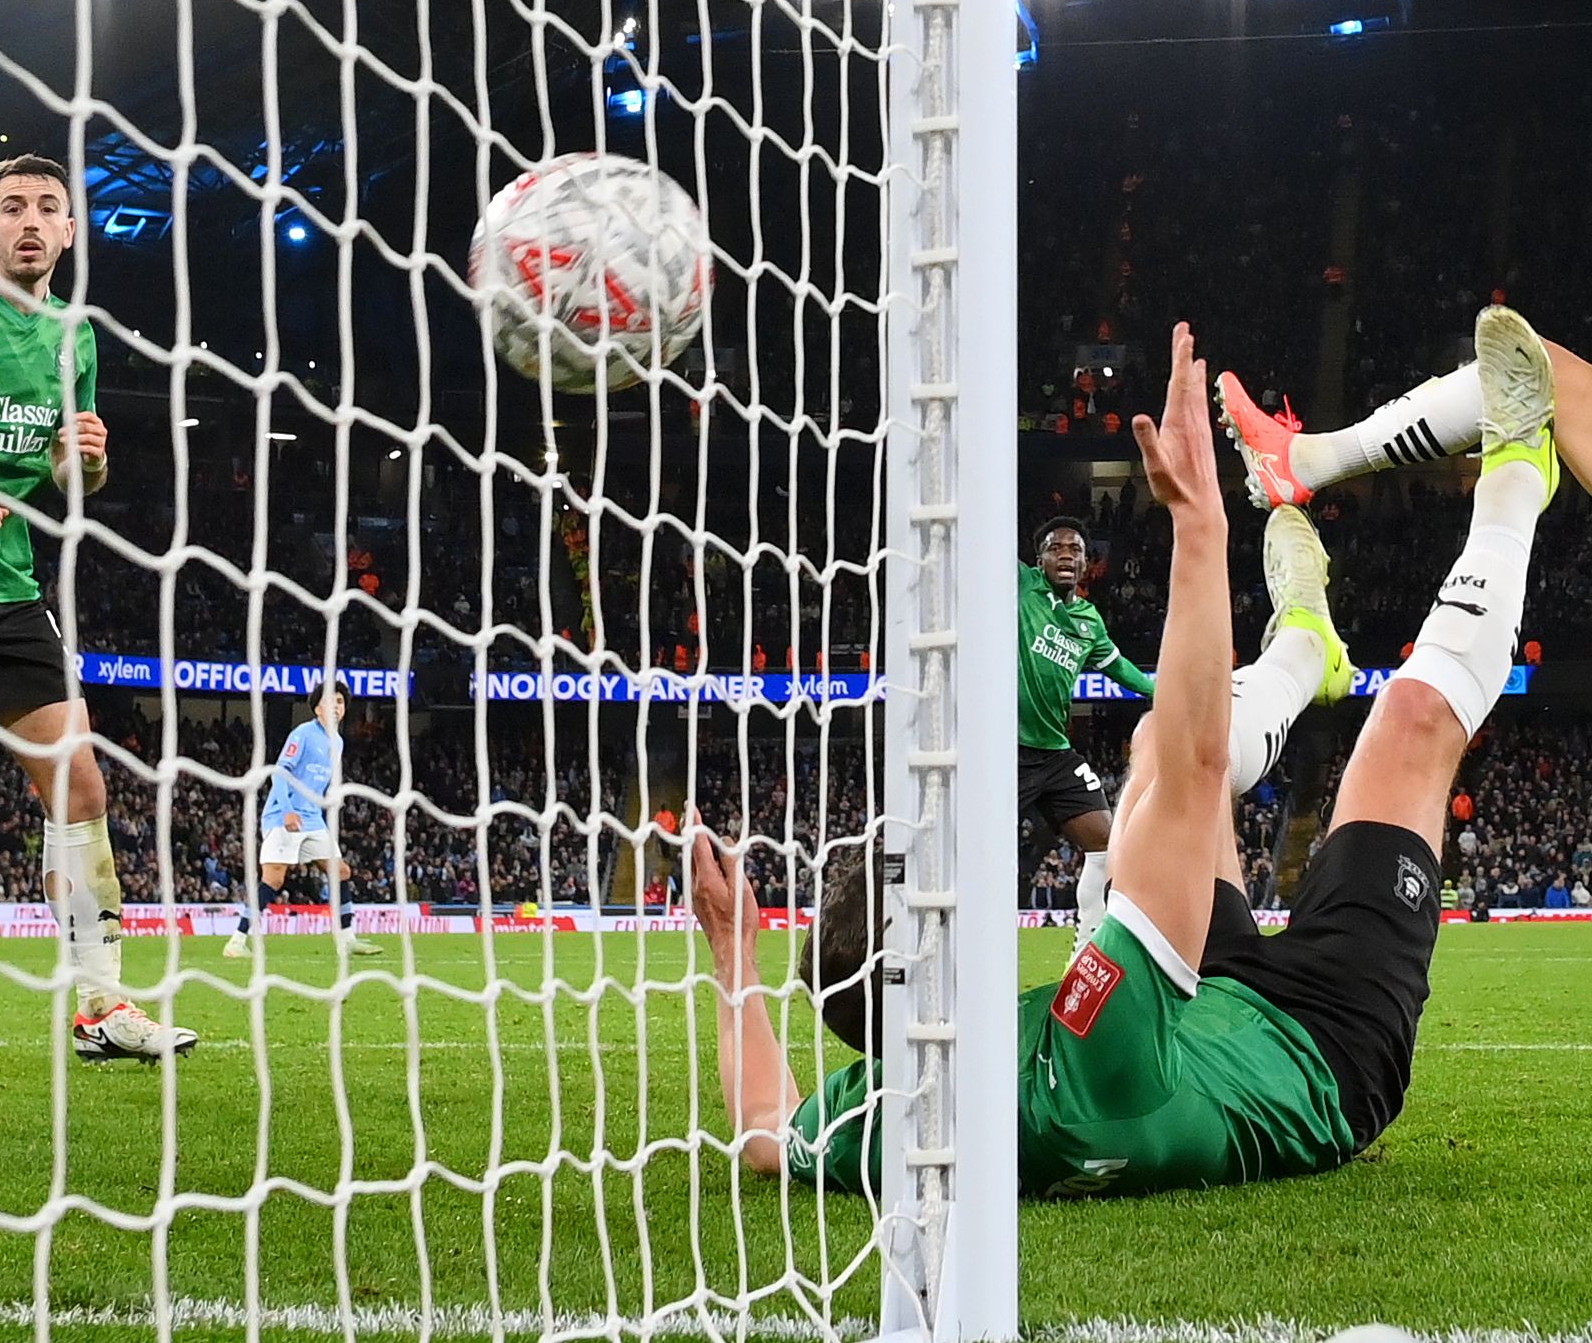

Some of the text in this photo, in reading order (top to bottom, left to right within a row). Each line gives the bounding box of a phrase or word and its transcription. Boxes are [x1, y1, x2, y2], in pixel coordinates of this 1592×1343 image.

[1043, 624, 1083, 656] Classic
[98, 656, 151, 685] xylem
[627, 674, 765, 701] PARTNER
[784, 677, 849, 701] xylem
[1074, 762, 1102, 792] 3
